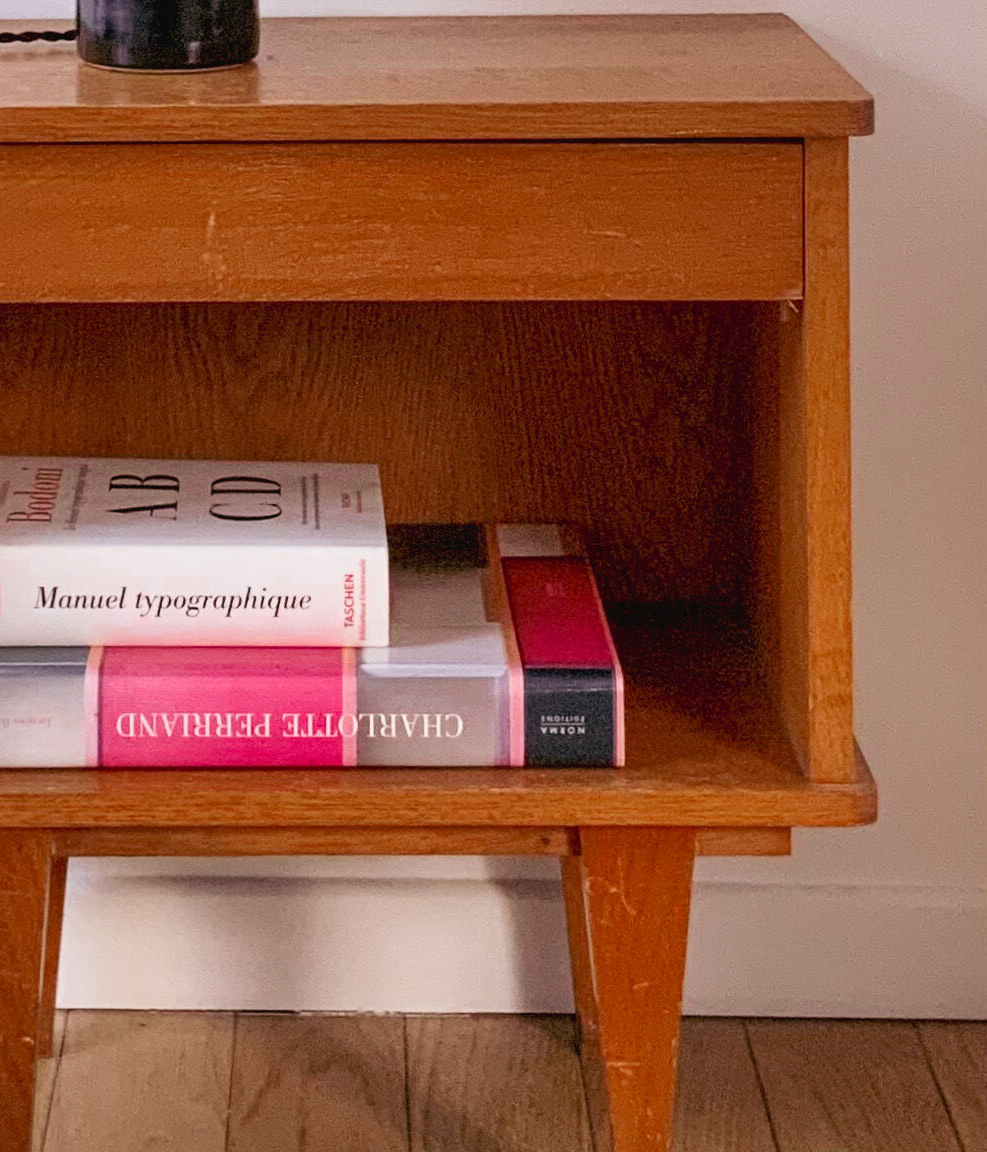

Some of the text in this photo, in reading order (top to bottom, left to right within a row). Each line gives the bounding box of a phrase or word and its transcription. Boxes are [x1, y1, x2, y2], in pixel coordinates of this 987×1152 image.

[6, 466, 63, 523] Bodoni
[34, 586, 312, 618] Manuel typographique
[343, 573, 354, 628] TASCHEN
[116, 713, 464, 738] CHARLOTTE PERRIAND
[540, 726, 586, 735] NORMA
